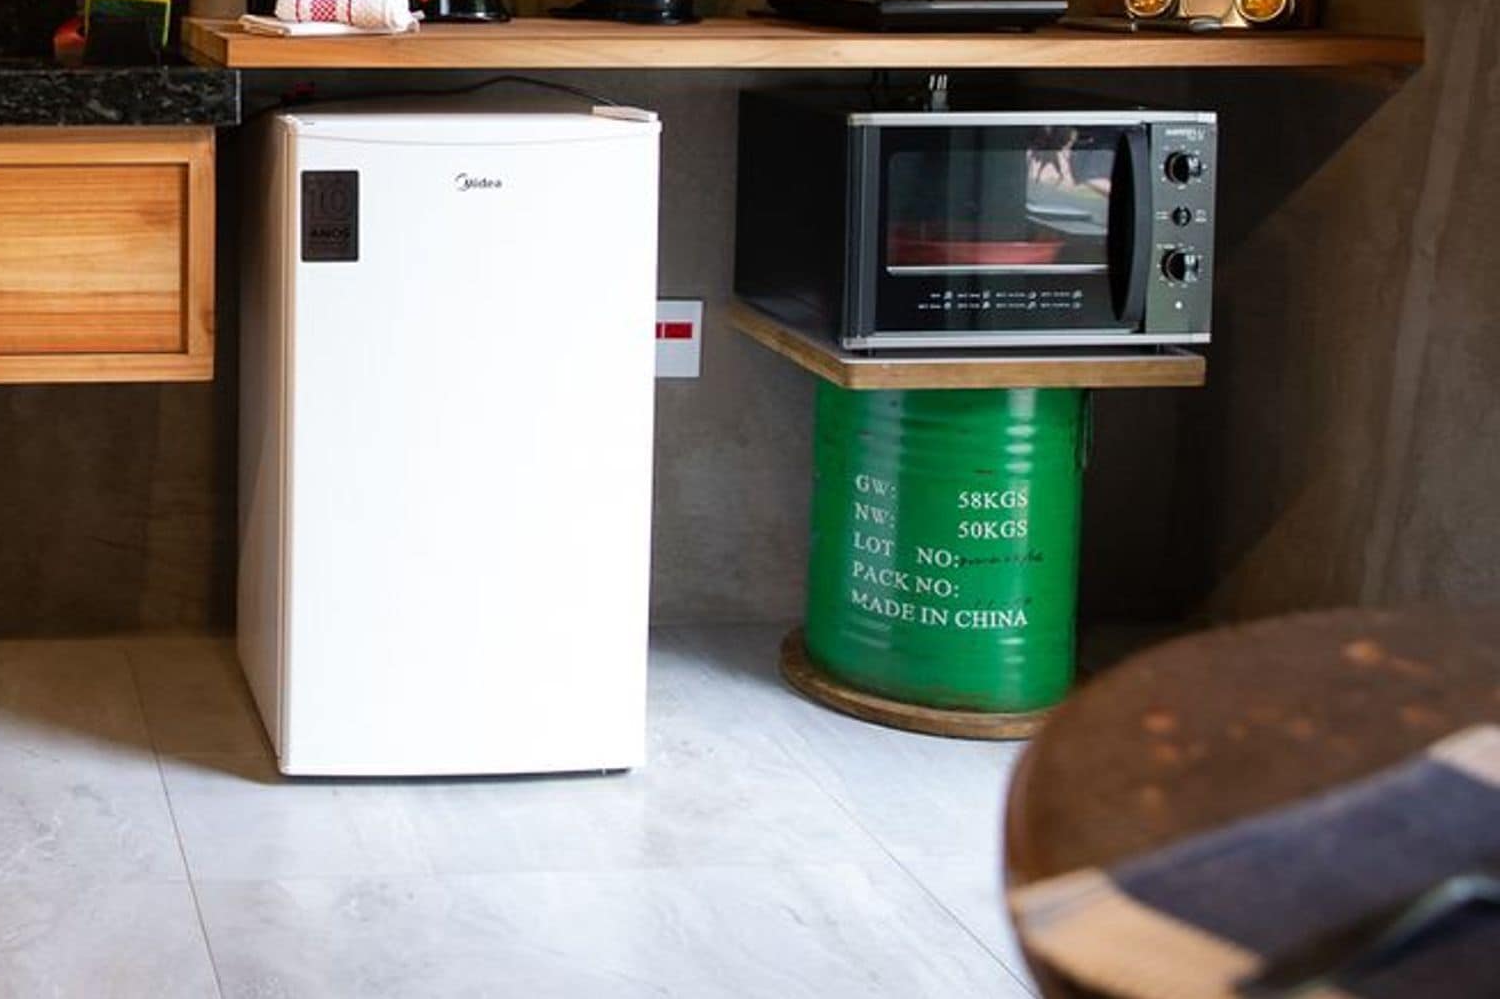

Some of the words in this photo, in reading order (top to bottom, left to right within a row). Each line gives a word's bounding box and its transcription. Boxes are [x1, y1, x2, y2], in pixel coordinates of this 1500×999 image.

[454, 172, 503, 192] Midea
[855, 474, 897, 499] GW:
[957, 490, 1029, 510] 58KGS
[854, 502, 896, 529] NW:
[957, 519, 1029, 539] 50KGS
[853, 531, 895, 557] LOT
[916, 547, 960, 569] NO:
[852, 561, 909, 591] PACK
[915, 577, 960, 599] NO:
[850, 589, 915, 622] MADE
[921, 609, 949, 627] IN
[955, 609, 1029, 629] CHINA
